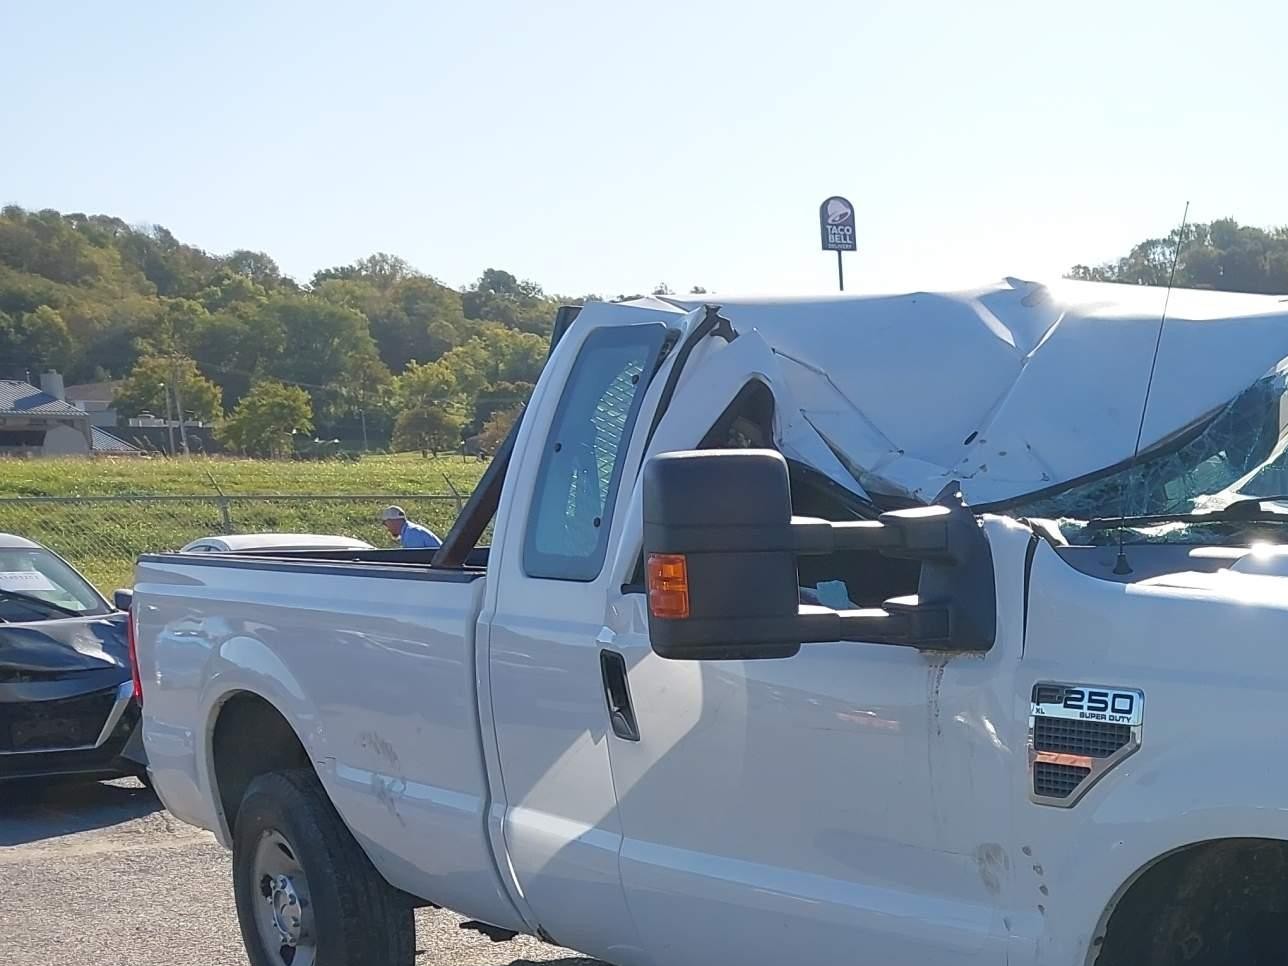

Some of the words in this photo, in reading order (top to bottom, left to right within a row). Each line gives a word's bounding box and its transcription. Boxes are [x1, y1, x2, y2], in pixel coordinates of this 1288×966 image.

[826, 225, 852, 235] TACO
[828, 234, 852, 243] BELL
[1080, 711, 1107, 721] SUPER
[1108, 714, 1132, 723] DUTY
